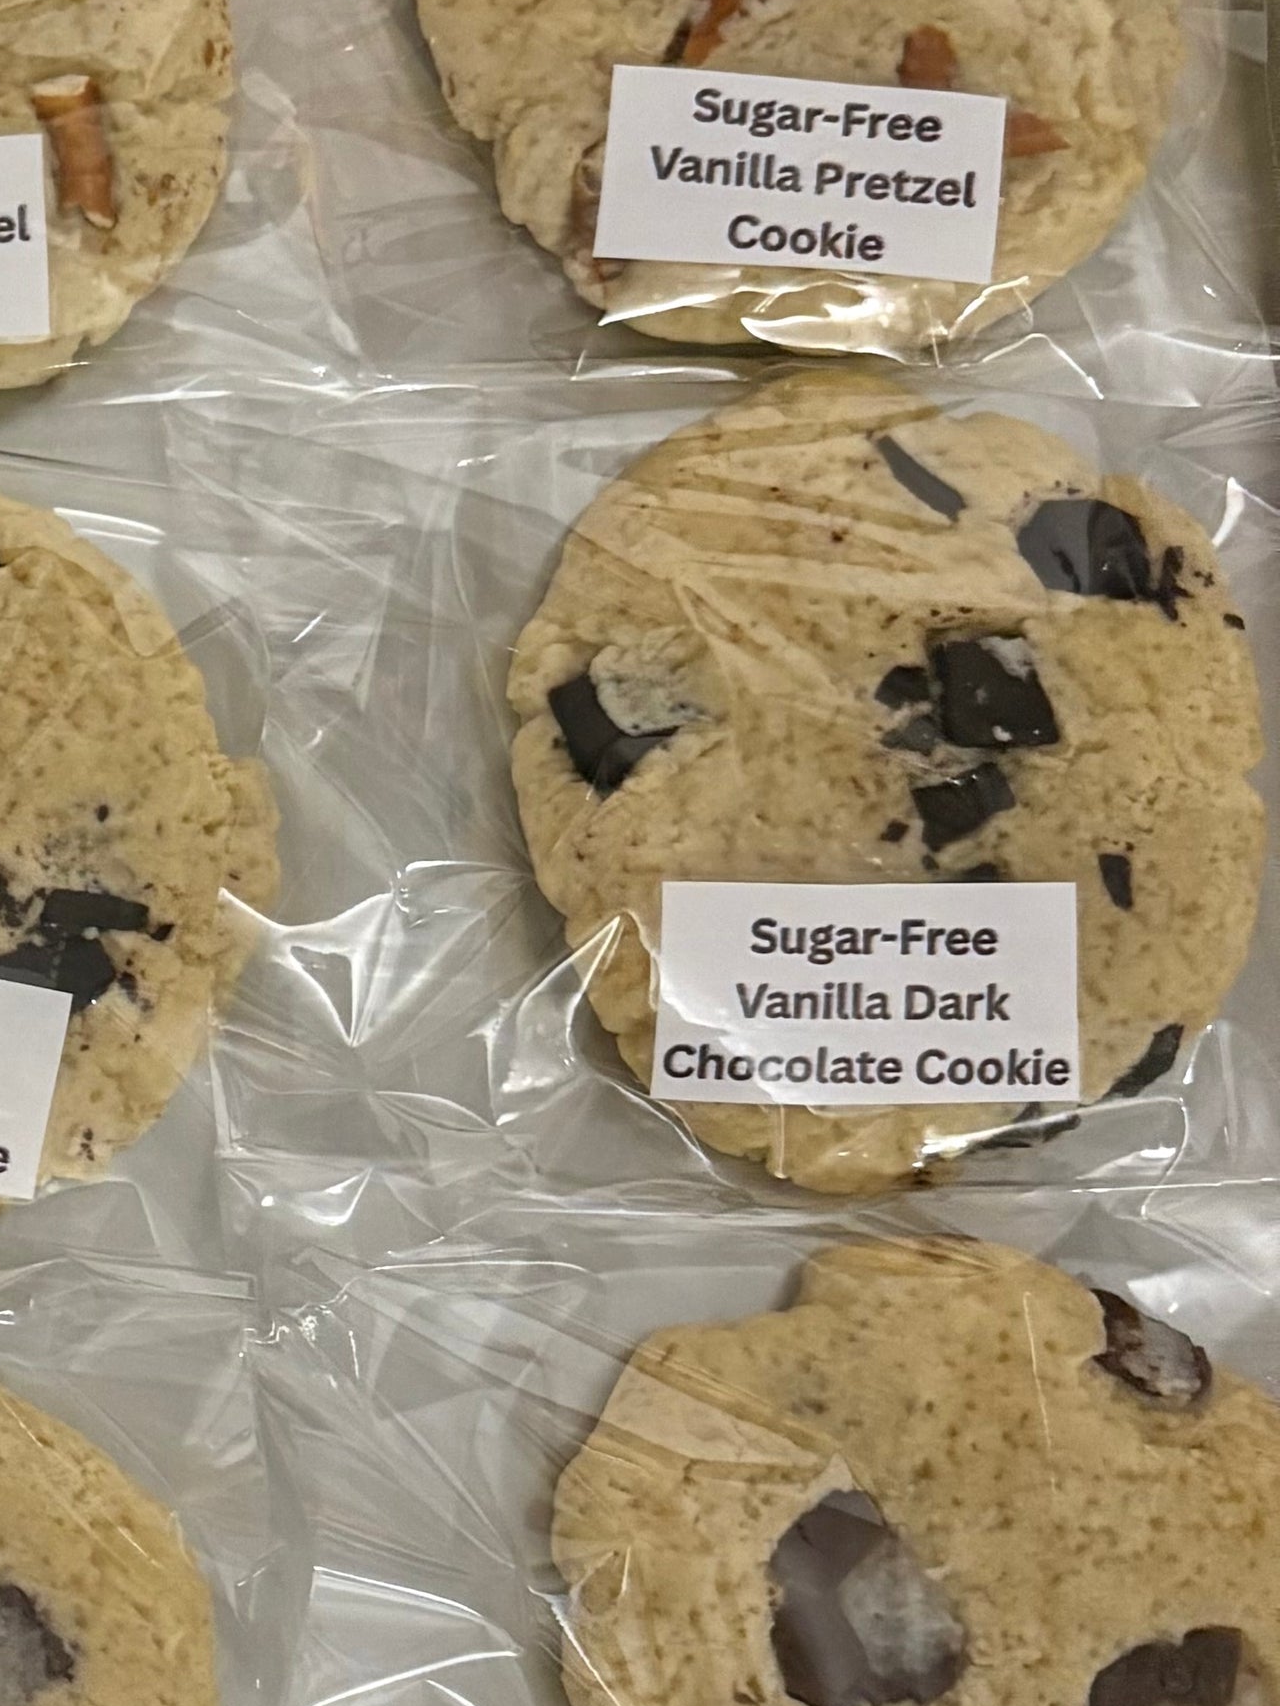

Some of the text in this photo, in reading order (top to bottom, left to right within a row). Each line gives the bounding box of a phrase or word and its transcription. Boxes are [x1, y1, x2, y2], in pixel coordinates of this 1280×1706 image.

[692, 87, 943, 143] Sugar-Free
[650, 145, 977, 209] Vanilla Pretzel
[727, 214, 886, 262] Cookie
[750, 917, 999, 966] Sugar-Free
[735, 981, 1011, 1022] Vanilla Dark
[662, 1043, 1071, 1086] Chocolate Cookie
